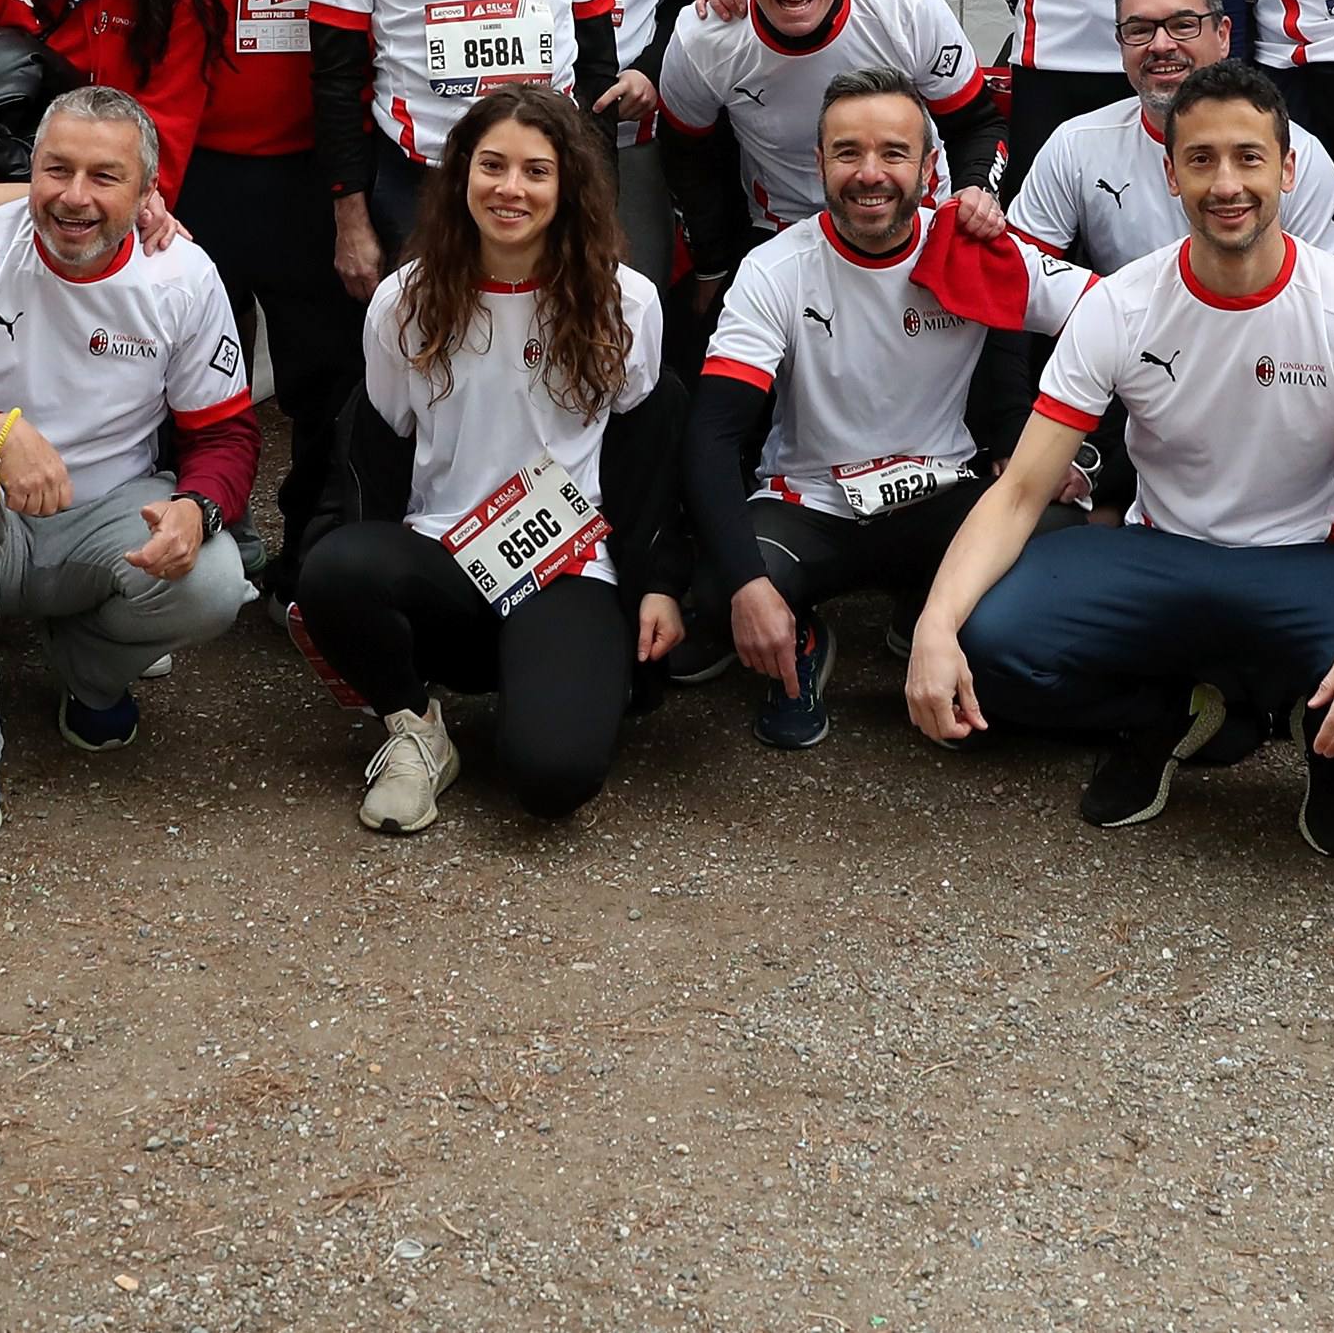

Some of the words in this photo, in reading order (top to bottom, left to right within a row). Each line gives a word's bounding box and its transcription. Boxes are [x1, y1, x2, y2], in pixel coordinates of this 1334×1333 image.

[433, 8, 462, 17] Lenovo
[487, 3, 512, 11] RELAY
[464, 37, 525, 69] 858A
[446, 82, 473, 95] asics
[924, 317, 965, 331] MILAN
[111, 343, 157, 358] MILAN
[1280, 362, 1325, 373] FONDAZIONE
[1279, 371, 1327, 387] MILAN
[494, 483, 518, 504] RELAY
[879, 472, 938, 506] 862A
[453, 520, 478, 542] Lenovo
[497, 507, 562, 570] 856C
[581, 520, 605, 542] MILANO
[543, 554, 568, 577] Telepass
[511, 580, 536, 606] asics
